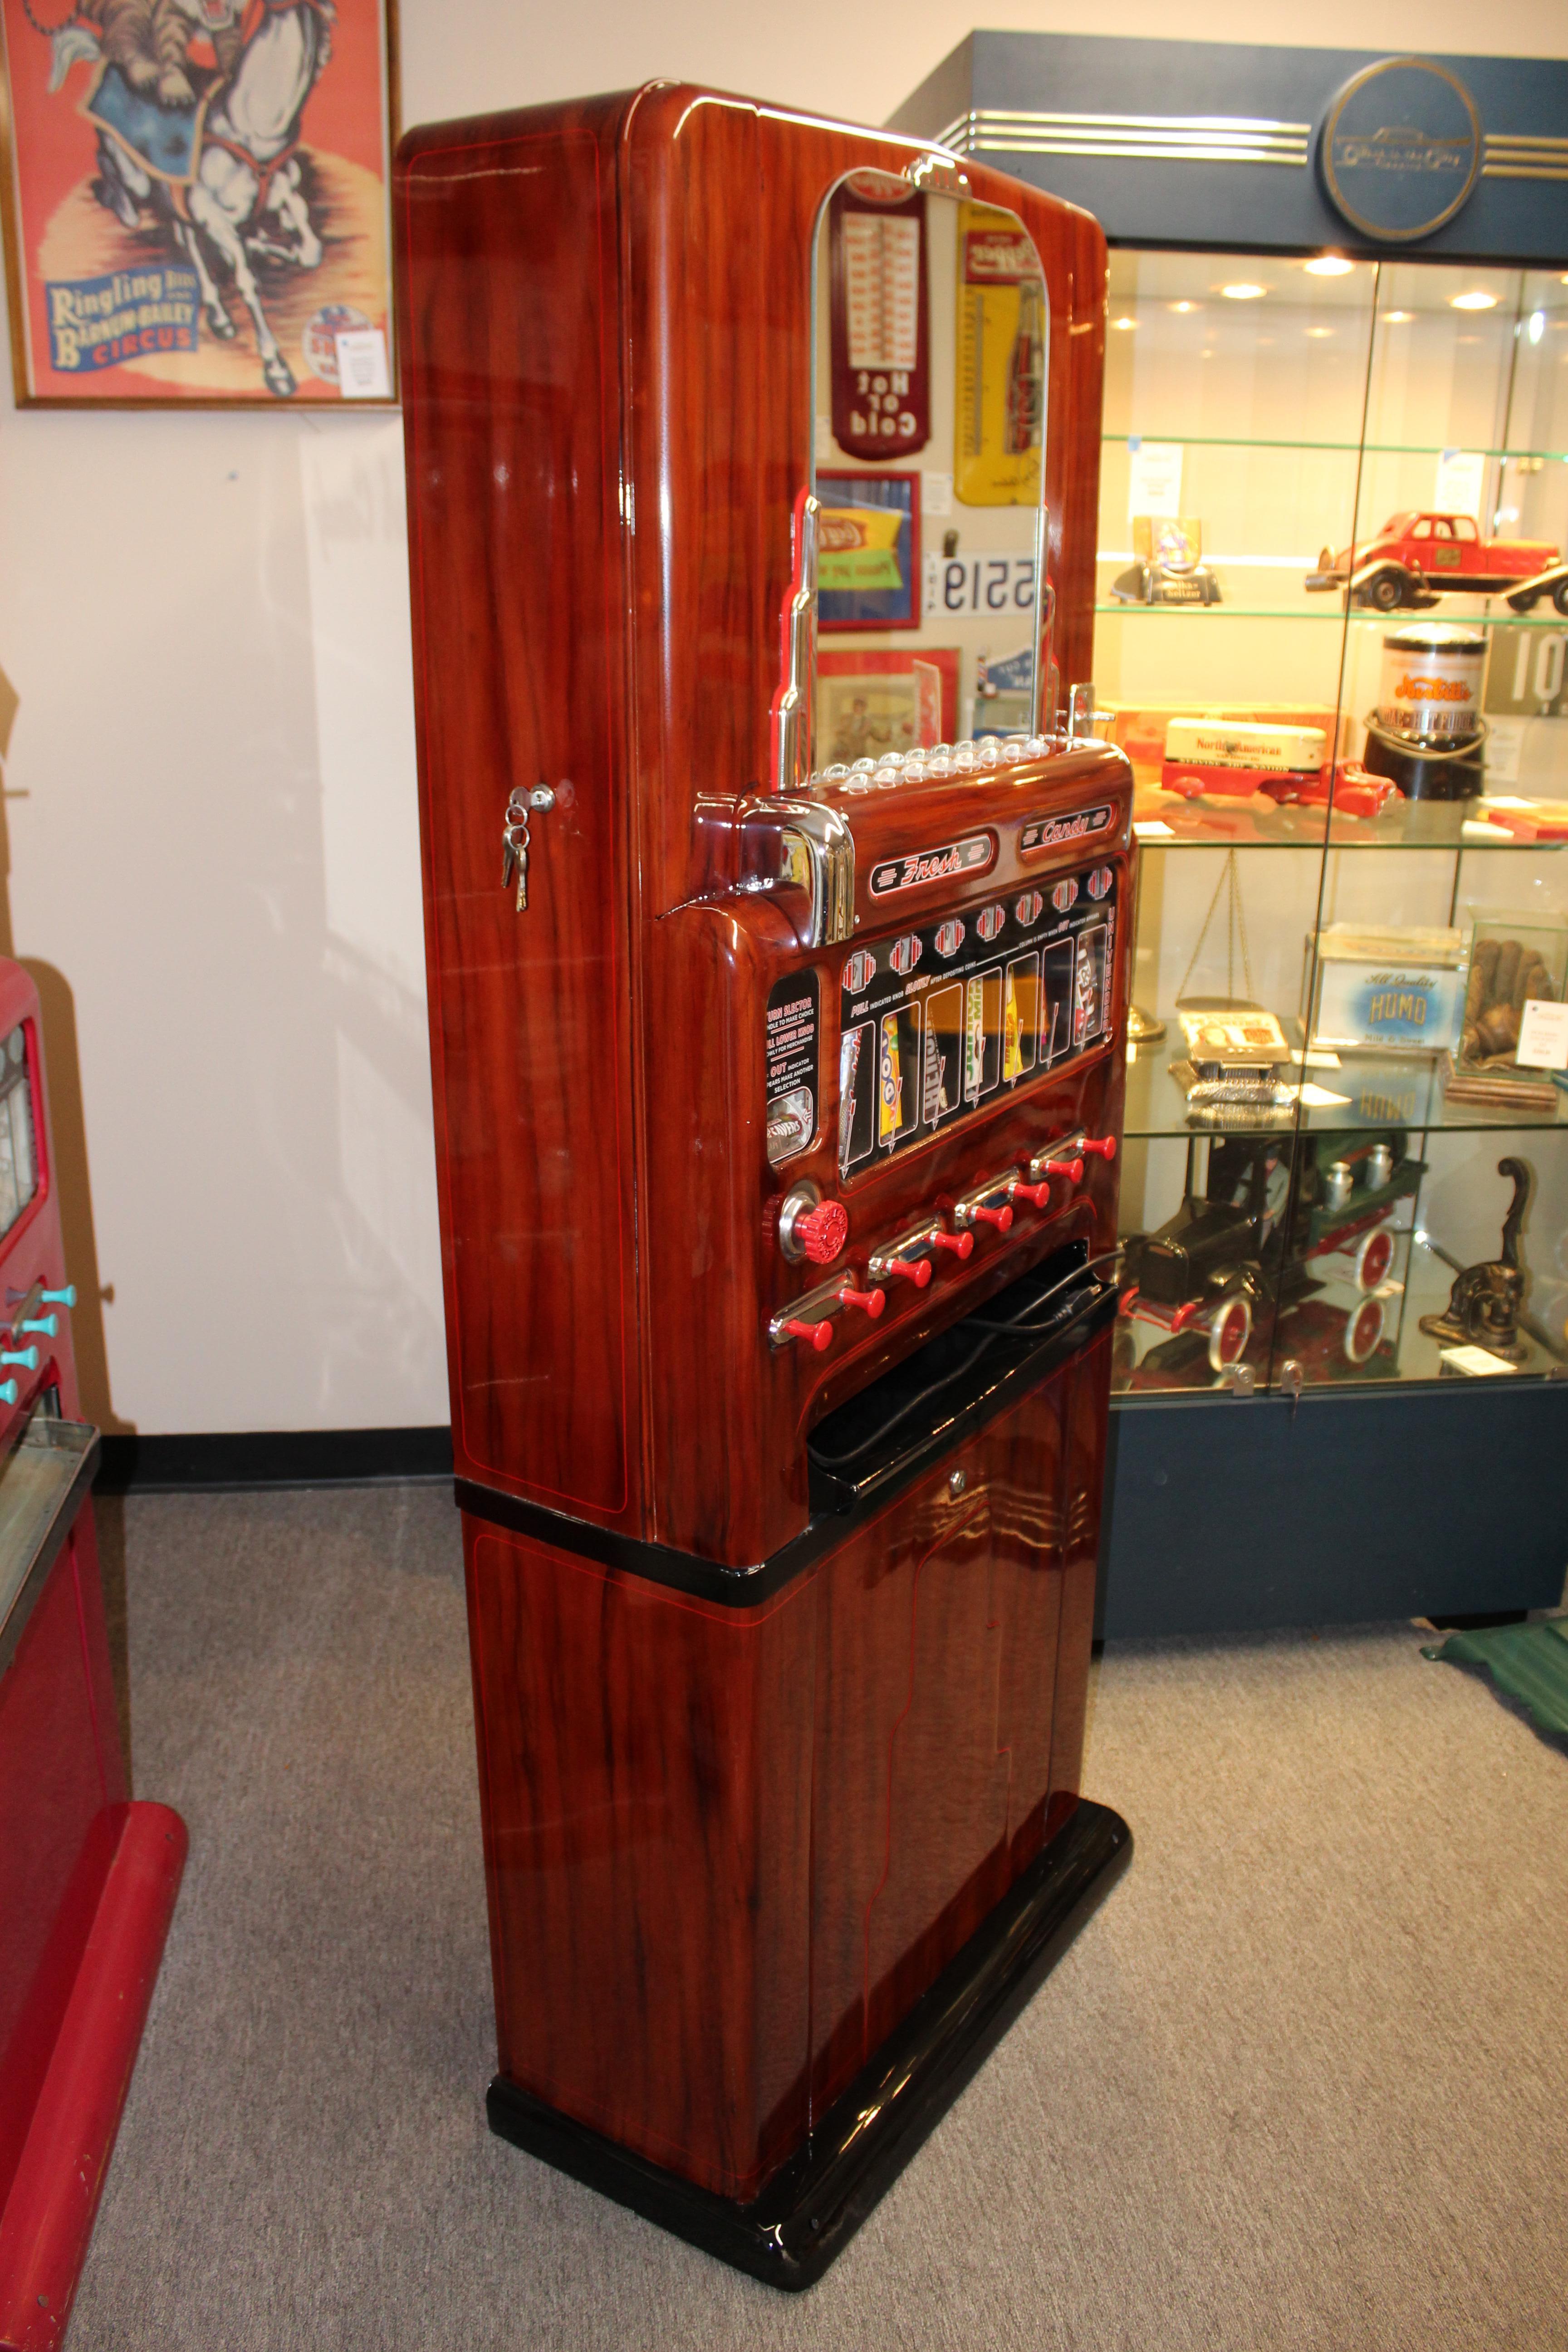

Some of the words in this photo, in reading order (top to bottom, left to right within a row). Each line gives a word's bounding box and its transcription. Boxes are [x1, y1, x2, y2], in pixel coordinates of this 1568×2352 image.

[50, 272, 162, 326] Ringling
[92, 327, 191, 365] CIRCUS
[1197, 737, 1225, 751] North
[1233, 740, 1282, 756] American
[901, 847, 962, 886] Fresh
[1043, 815, 1090, 844] Candy
[1057, 919, 1070, 933] OUT
[851, 1000, 869, 1018] PULL
[870, 995, 892, 1010] INDICATED
[892, 990, 904, 1001] KNOB
[905, 975, 931, 995] SLOWLY
[931, 975, 942, 985] AFTER
[943, 965, 965, 979] DEPOSITING
[965, 961, 976, 970] COINS
[784, 997, 812, 1017] SLECTOR
[786, 1014, 798, 1024] MAKE
[799, 1008, 814, 1019] CHOICE
[1368, 992, 1427, 1026] HUMO
[776, 1030, 797, 1046] LOWER
[798, 1023, 815, 1038] KNOB
[787, 1034, 813, 1049] MERCHANDISE
[770, 1062, 787, 1078] OUT
[788, 1058, 810, 1071] INDICATOR
[781, 1073, 794, 1083] MAKE
[794, 1064, 814, 1078] ANOTHER
[774, 1078, 801, 1093] SELECTION
